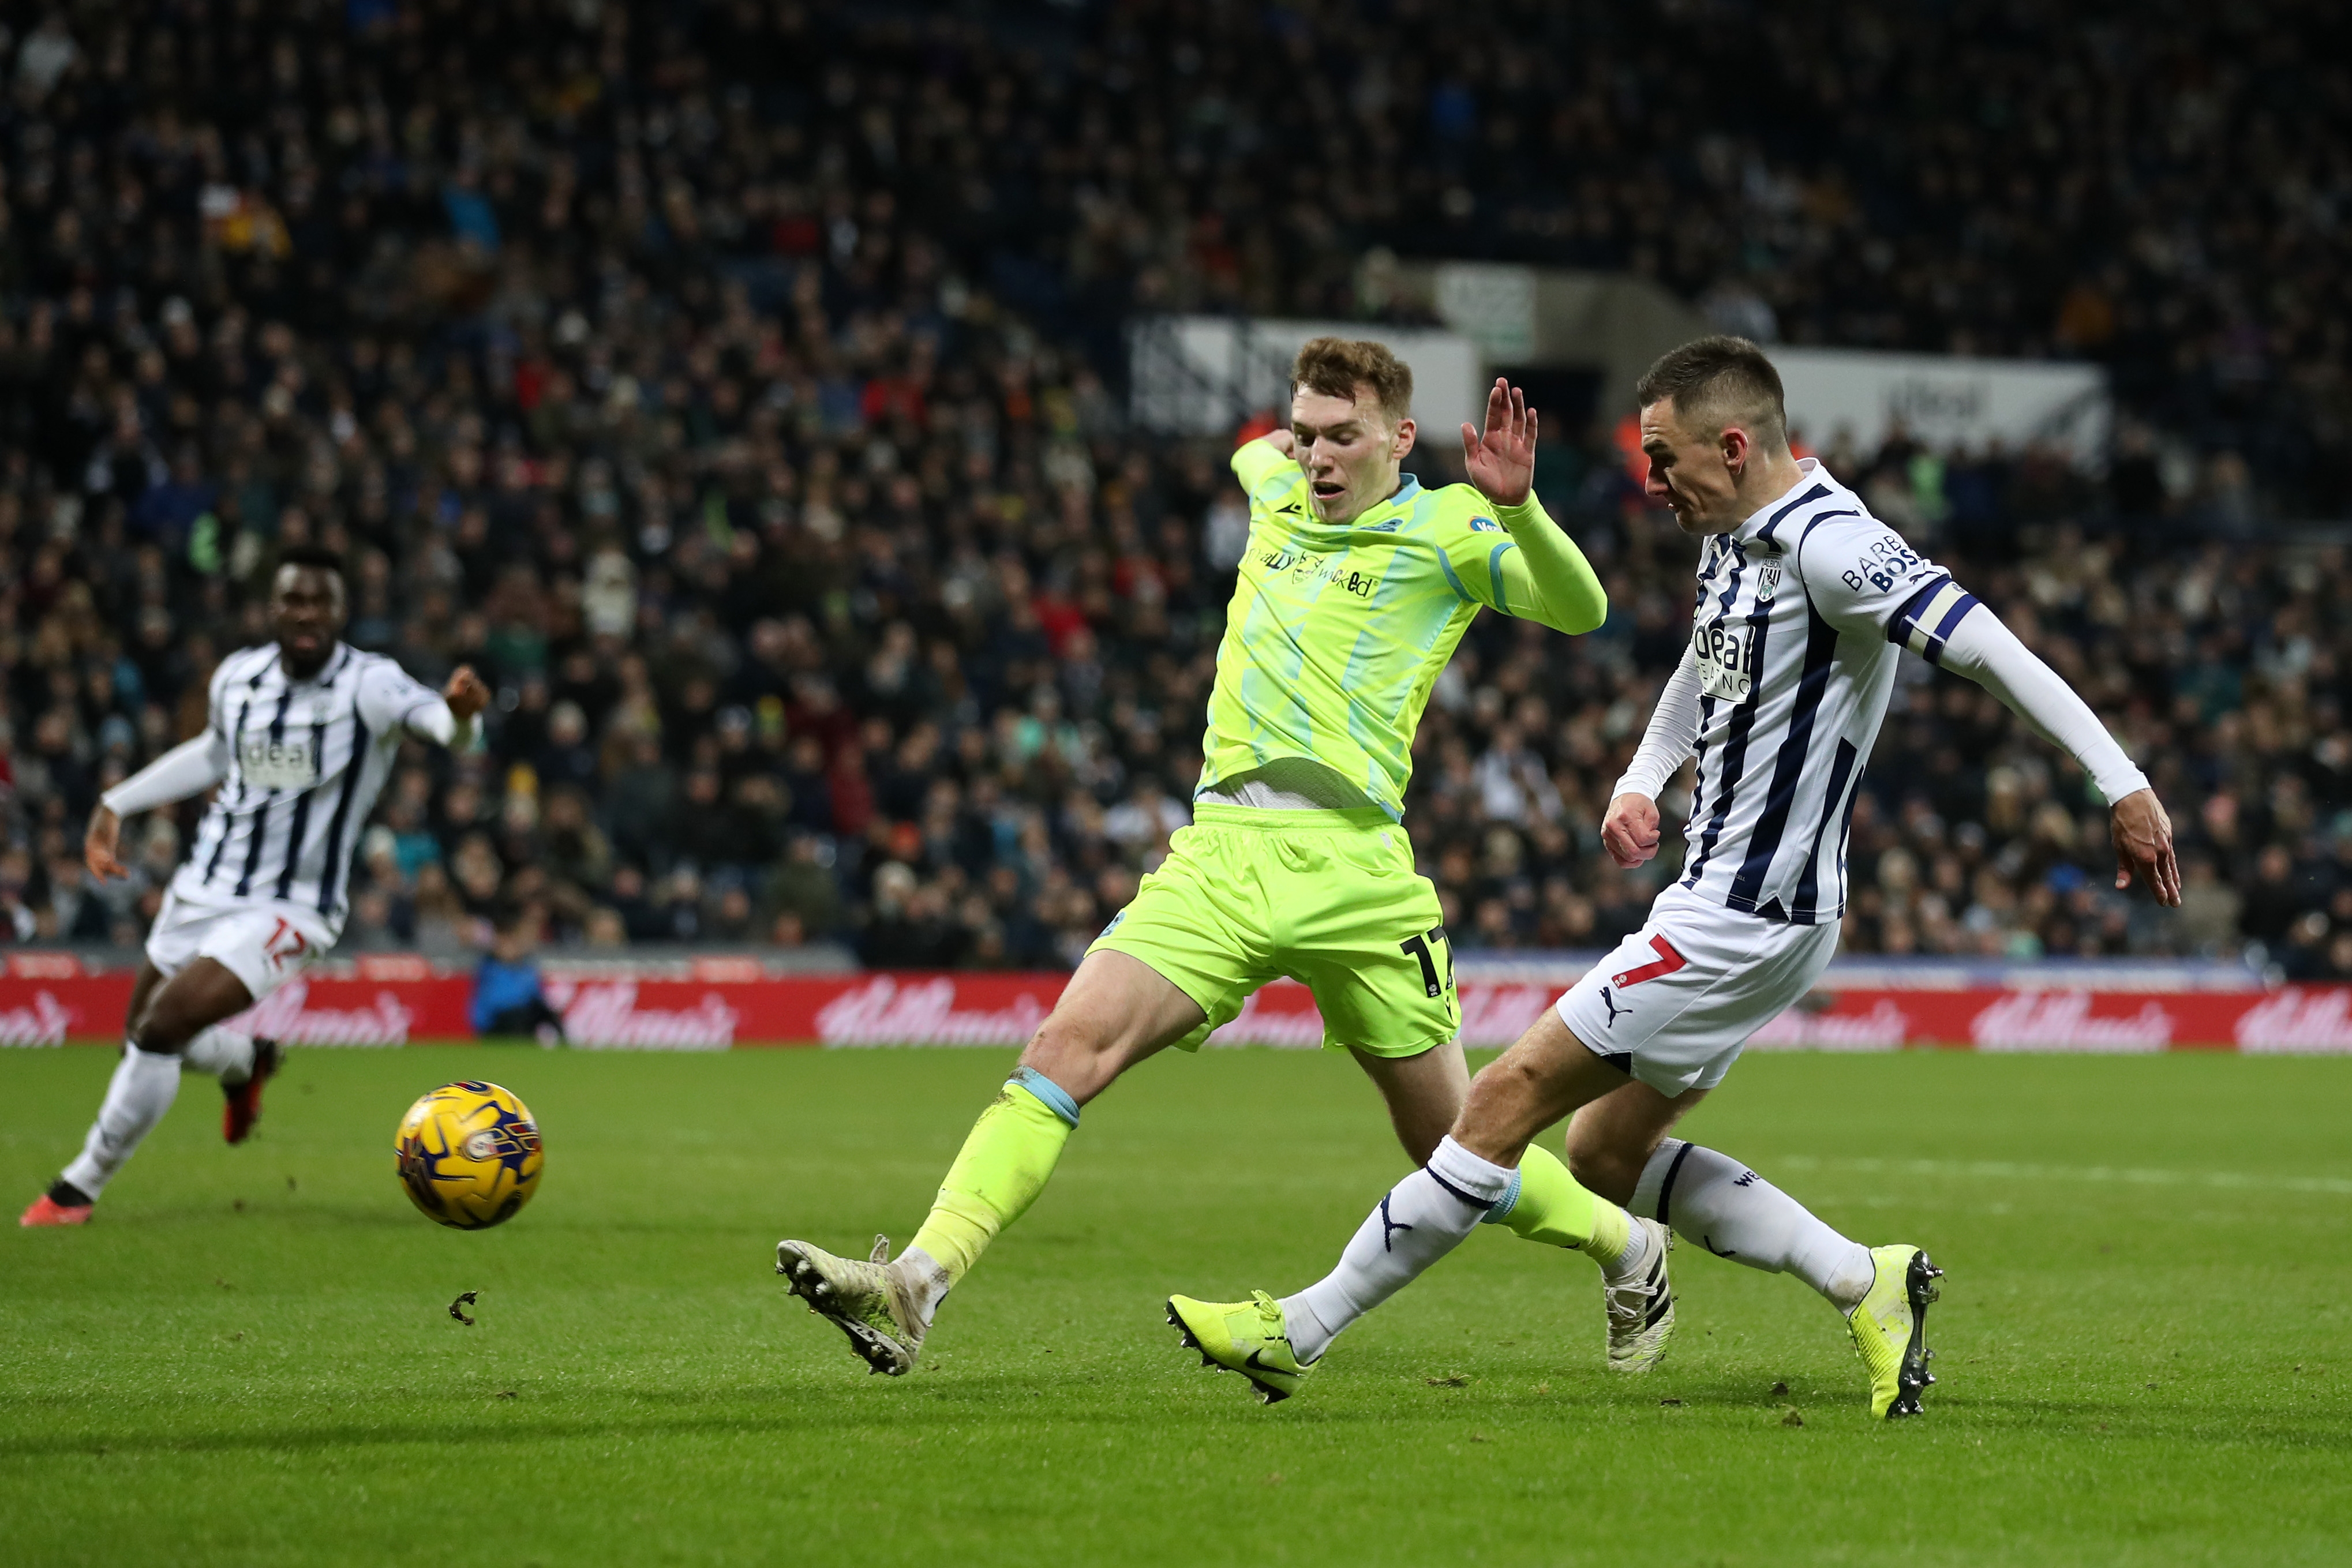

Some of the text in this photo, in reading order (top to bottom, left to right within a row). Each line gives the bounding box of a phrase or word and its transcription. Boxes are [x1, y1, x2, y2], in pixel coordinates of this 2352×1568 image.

[1841, 535, 1906, 592] BARB
[1870, 549, 1918, 593] BOS
[264, 917, 307, 971] 12
[1612, 933, 1687, 989] 7
